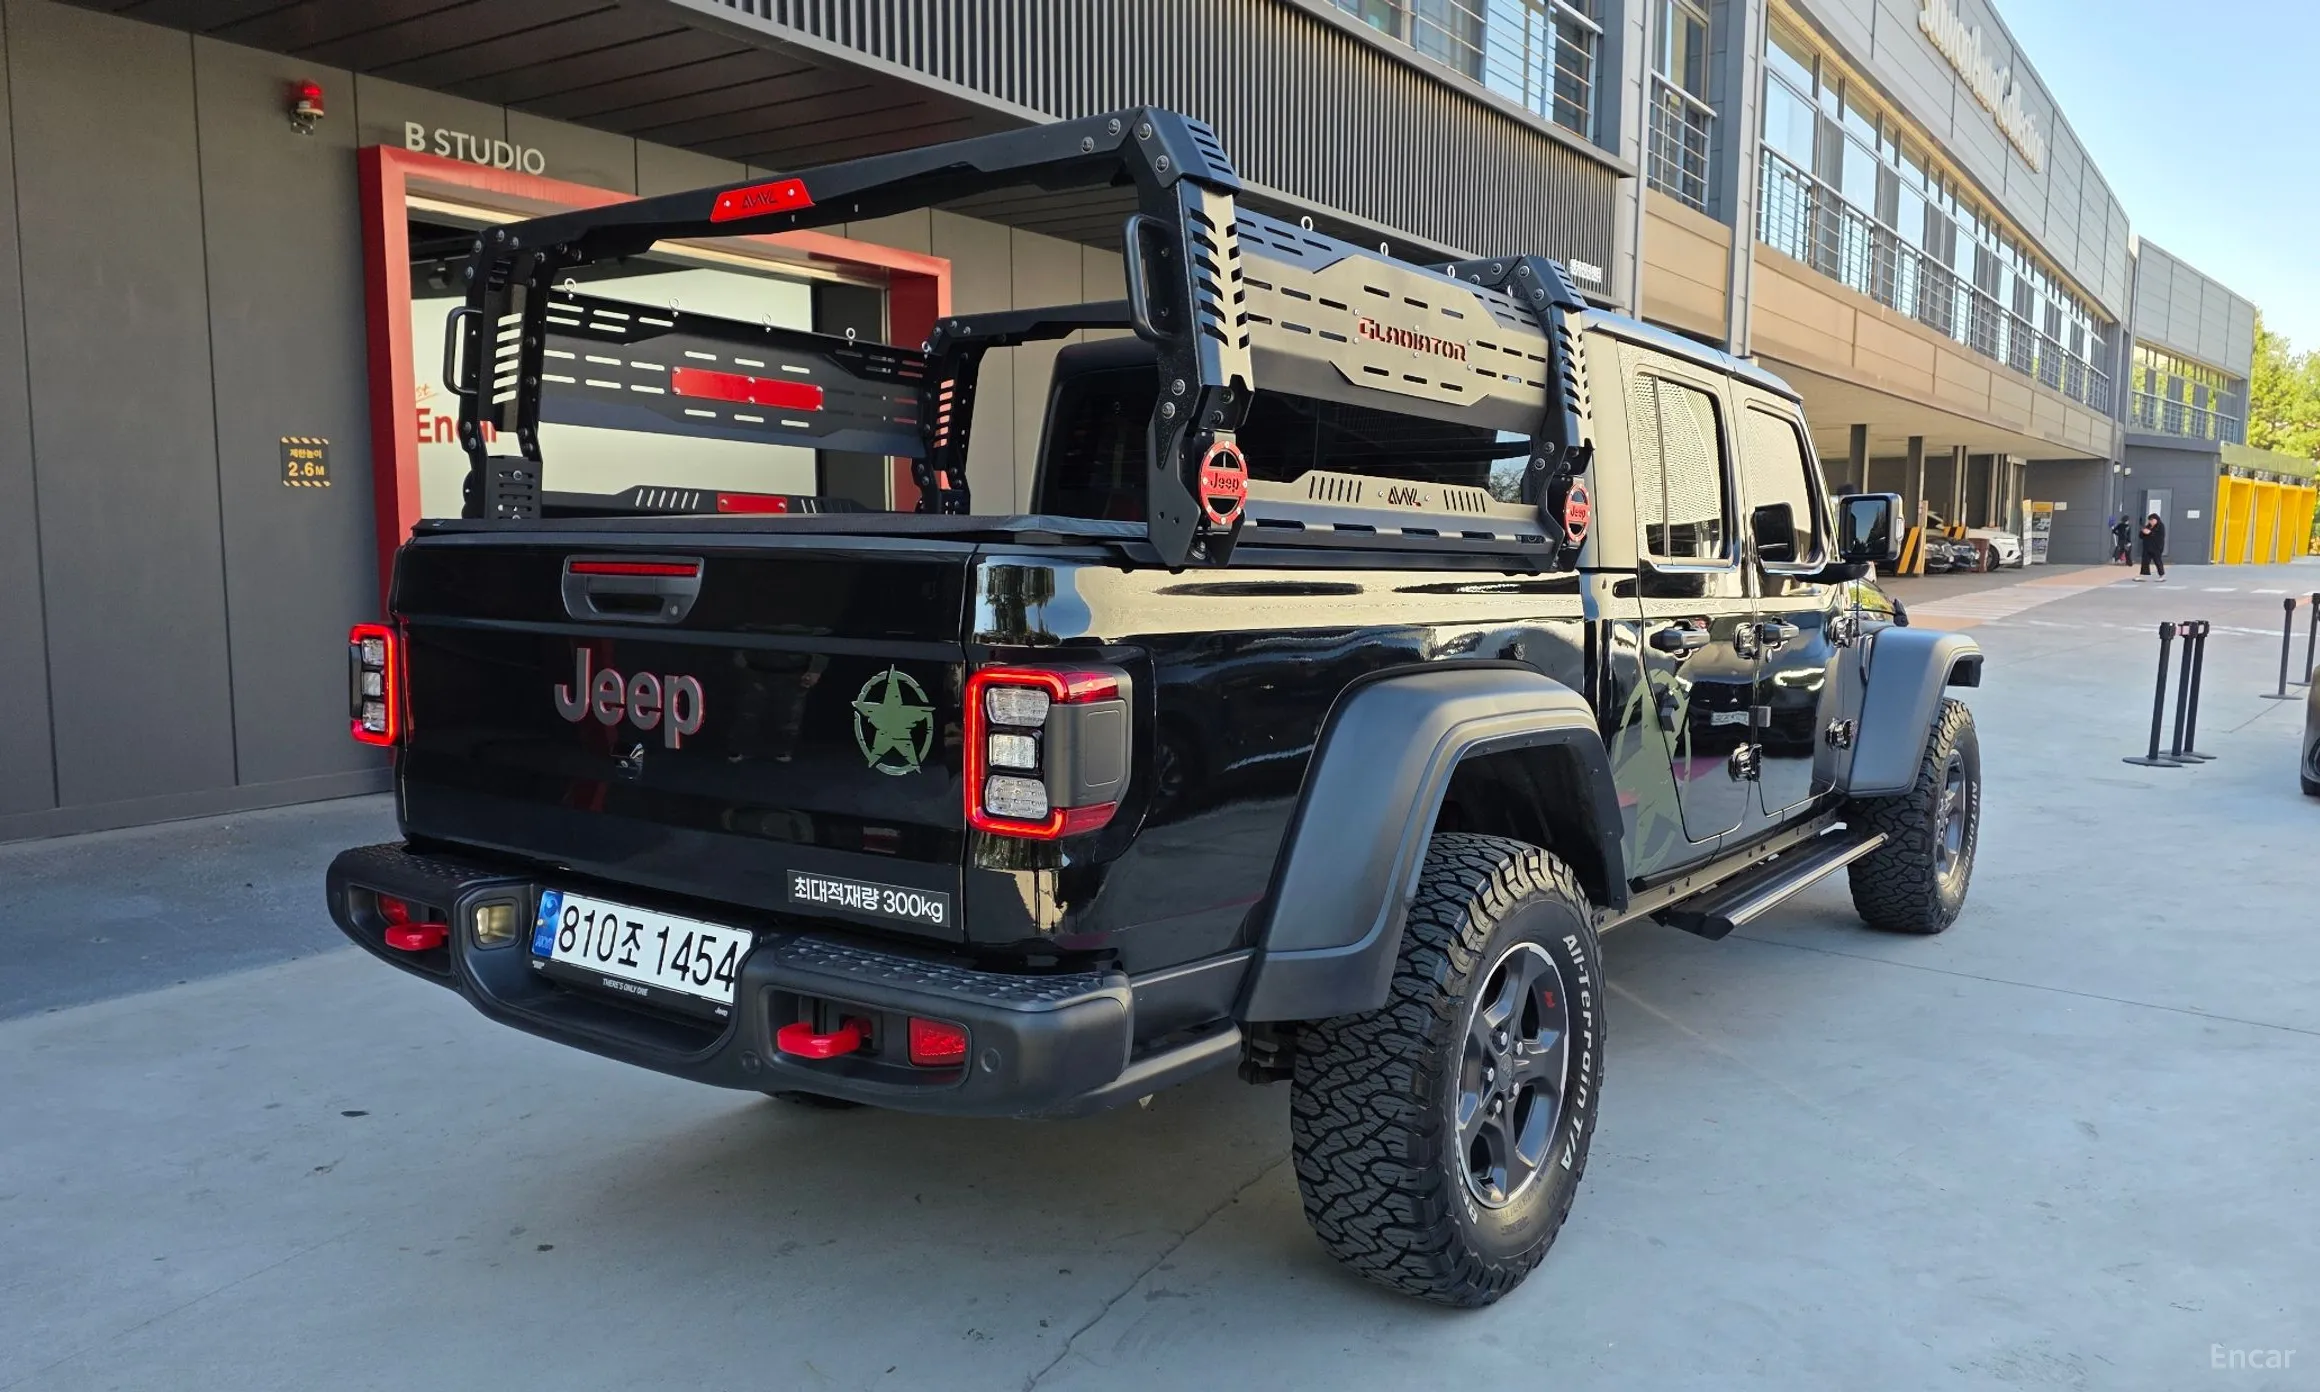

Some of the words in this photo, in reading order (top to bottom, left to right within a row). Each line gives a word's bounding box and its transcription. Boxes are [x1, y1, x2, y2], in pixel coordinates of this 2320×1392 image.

[405, 121, 426, 152] B
[434, 128, 546, 176] STUDIO
[1359, 317, 1467, 362] GLADIATOR
[1210, 472, 1240, 493] Jeep
[1570, 505, 1586, 521] Jeep
[554, 647, 706, 749] Jeep
[794, 876, 880, 911] 최대적재량
[882, 890, 944, 924] 300kg
[558, 905, 644, 968] 810조
[656, 926, 739, 993] 1454
[623, 984, 637, 994] ONLY
[637, 987, 649, 997] ONE
[1561, 933, 1593, 1110] All-Terrain
[1559, 1115, 1584, 1172] T/A
